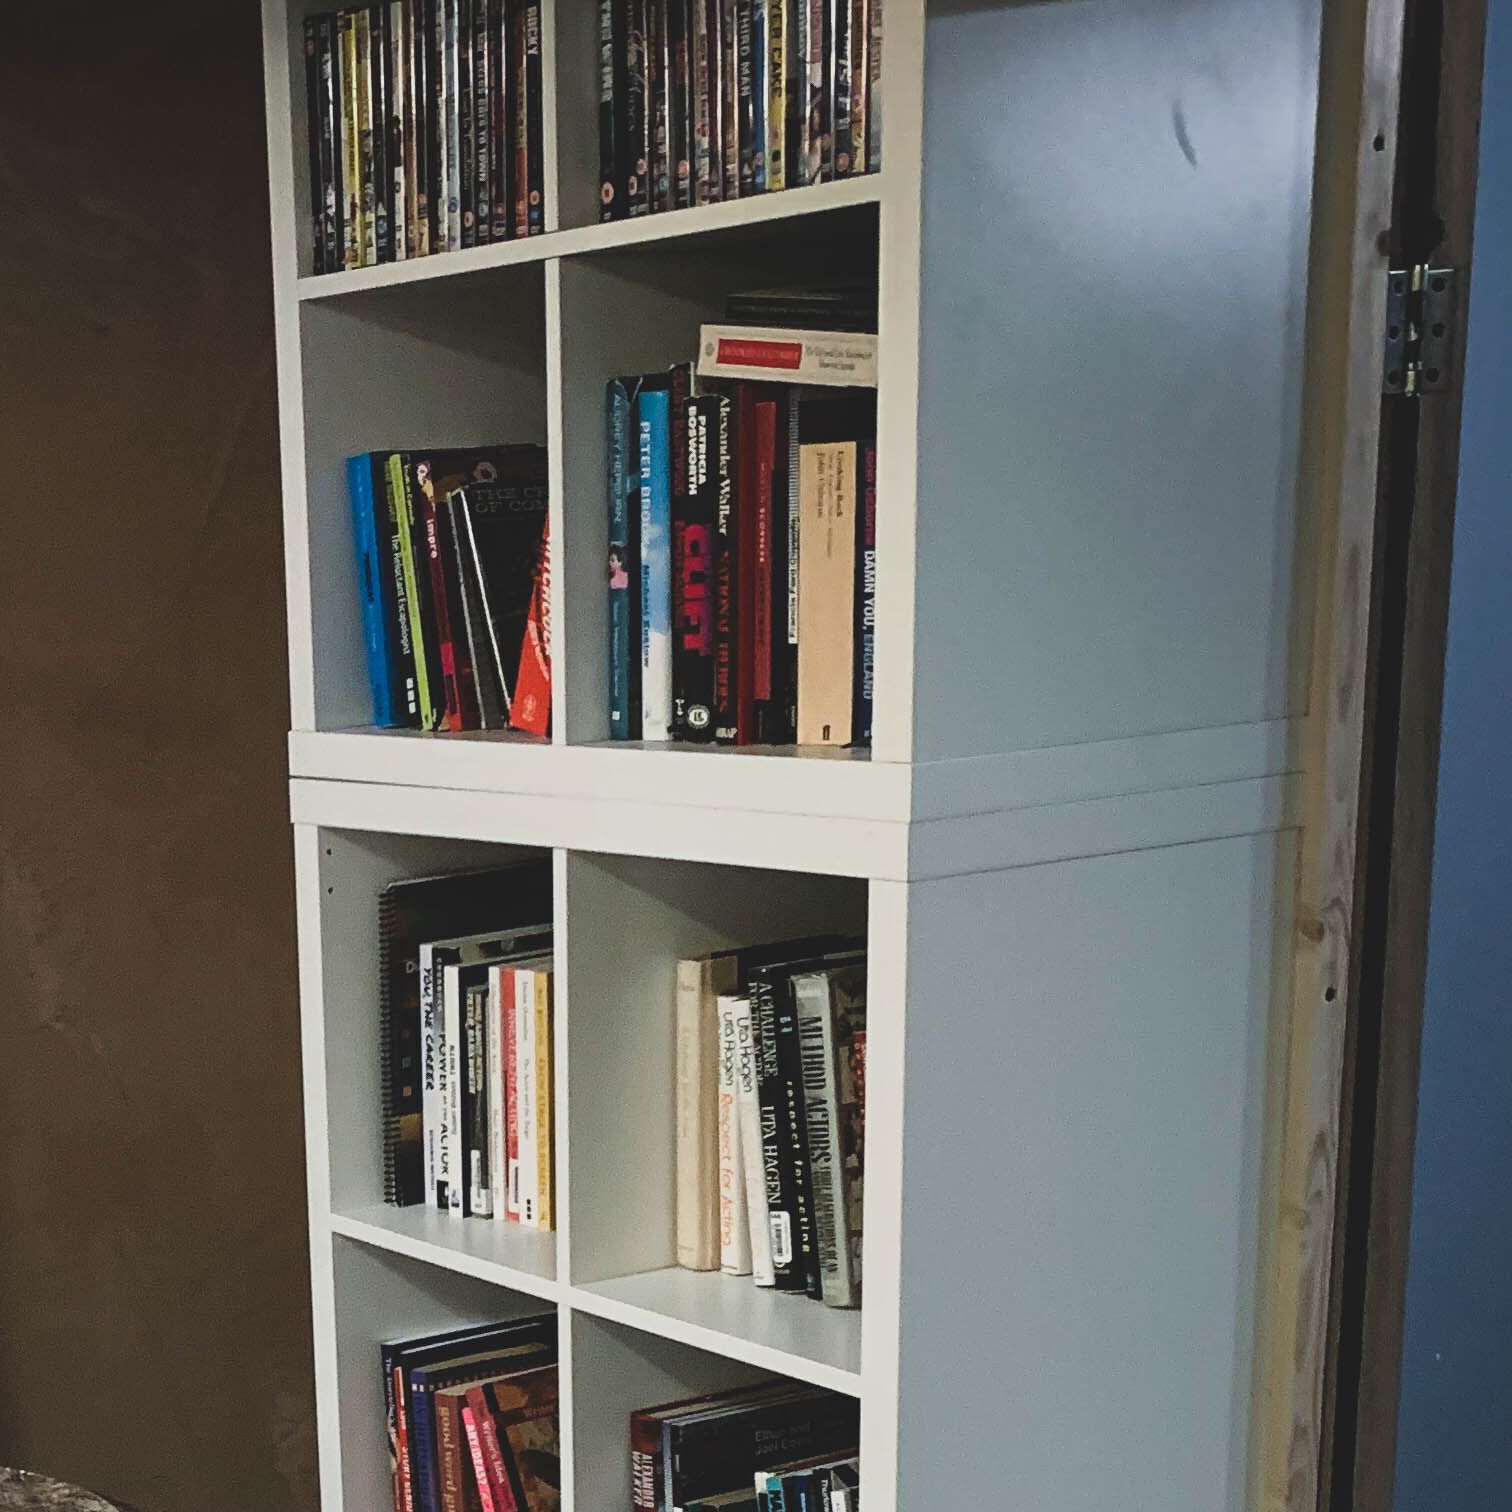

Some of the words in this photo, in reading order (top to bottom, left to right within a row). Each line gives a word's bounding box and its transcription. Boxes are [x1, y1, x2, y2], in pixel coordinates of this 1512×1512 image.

[527, 6, 540, 56] ROCKY
[739, 9, 752, 57] THIRD
[740, 62, 752, 97] MAN
[771, 48, 783, 98] CAKE
[612, 392, 623, 459] AUDREY
[640, 420, 651, 479] PETER
[687, 404, 698, 496] BOSWORTH
[697, 414, 707, 485] PATRICIA
[717, 394, 732, 475] Alexander
[612, 461, 624, 523] HEPBURN
[717, 478, 731, 536] Walker
[390, 534, 403, 552] The
[391, 553, 406, 597] Reluctant
[682, 523, 712, 657] CLIFT
[862, 550, 875, 593] DAMN
[394, 598, 411, 656] Escapologist
[861, 596, 875, 631] YOU,
[862, 633, 874, 700] ENGLAND
[760, 981, 773, 993] A
[722, 1011, 734, 1038] Uta
[736, 1016, 750, 1044] Uta
[760, 995, 779, 1077] CHALLENGE
[423, 1034, 436, 1091] CAREER
[438, 1033, 449, 1092] POWER
[722, 1040, 736, 1088] Hagen
[738, 1046, 753, 1094] Hagen
[799, 1015, 828, 1091] METHOD
[720, 1093, 734, 1162] Respect
[760, 1104, 776, 1139] UTA
[785, 1079, 802, 1150] respect
[807, 1096, 833, 1163] ACTORS
[722, 1168, 734, 1190] for
[762, 1144, 782, 1206] HAGEN
[793, 1159, 806, 1185] for
[720, 1196, 735, 1247] Acting
[796, 1195, 812, 1254] acting
[438, 1406, 454, 1448] good
[465, 1423, 481, 1447] ANY
[481, 1420, 498, 1460] Writer's
[491, 1460, 506, 1484] Idea
[401, 1446, 412, 1480] STORY
[444, 1450, 457, 1492] word
[470, 1448, 487, 1486] IDEAS?
[631, 1450, 643, 1506] WALKER
[641, 1454, 656, 1509] ALEXANDER
